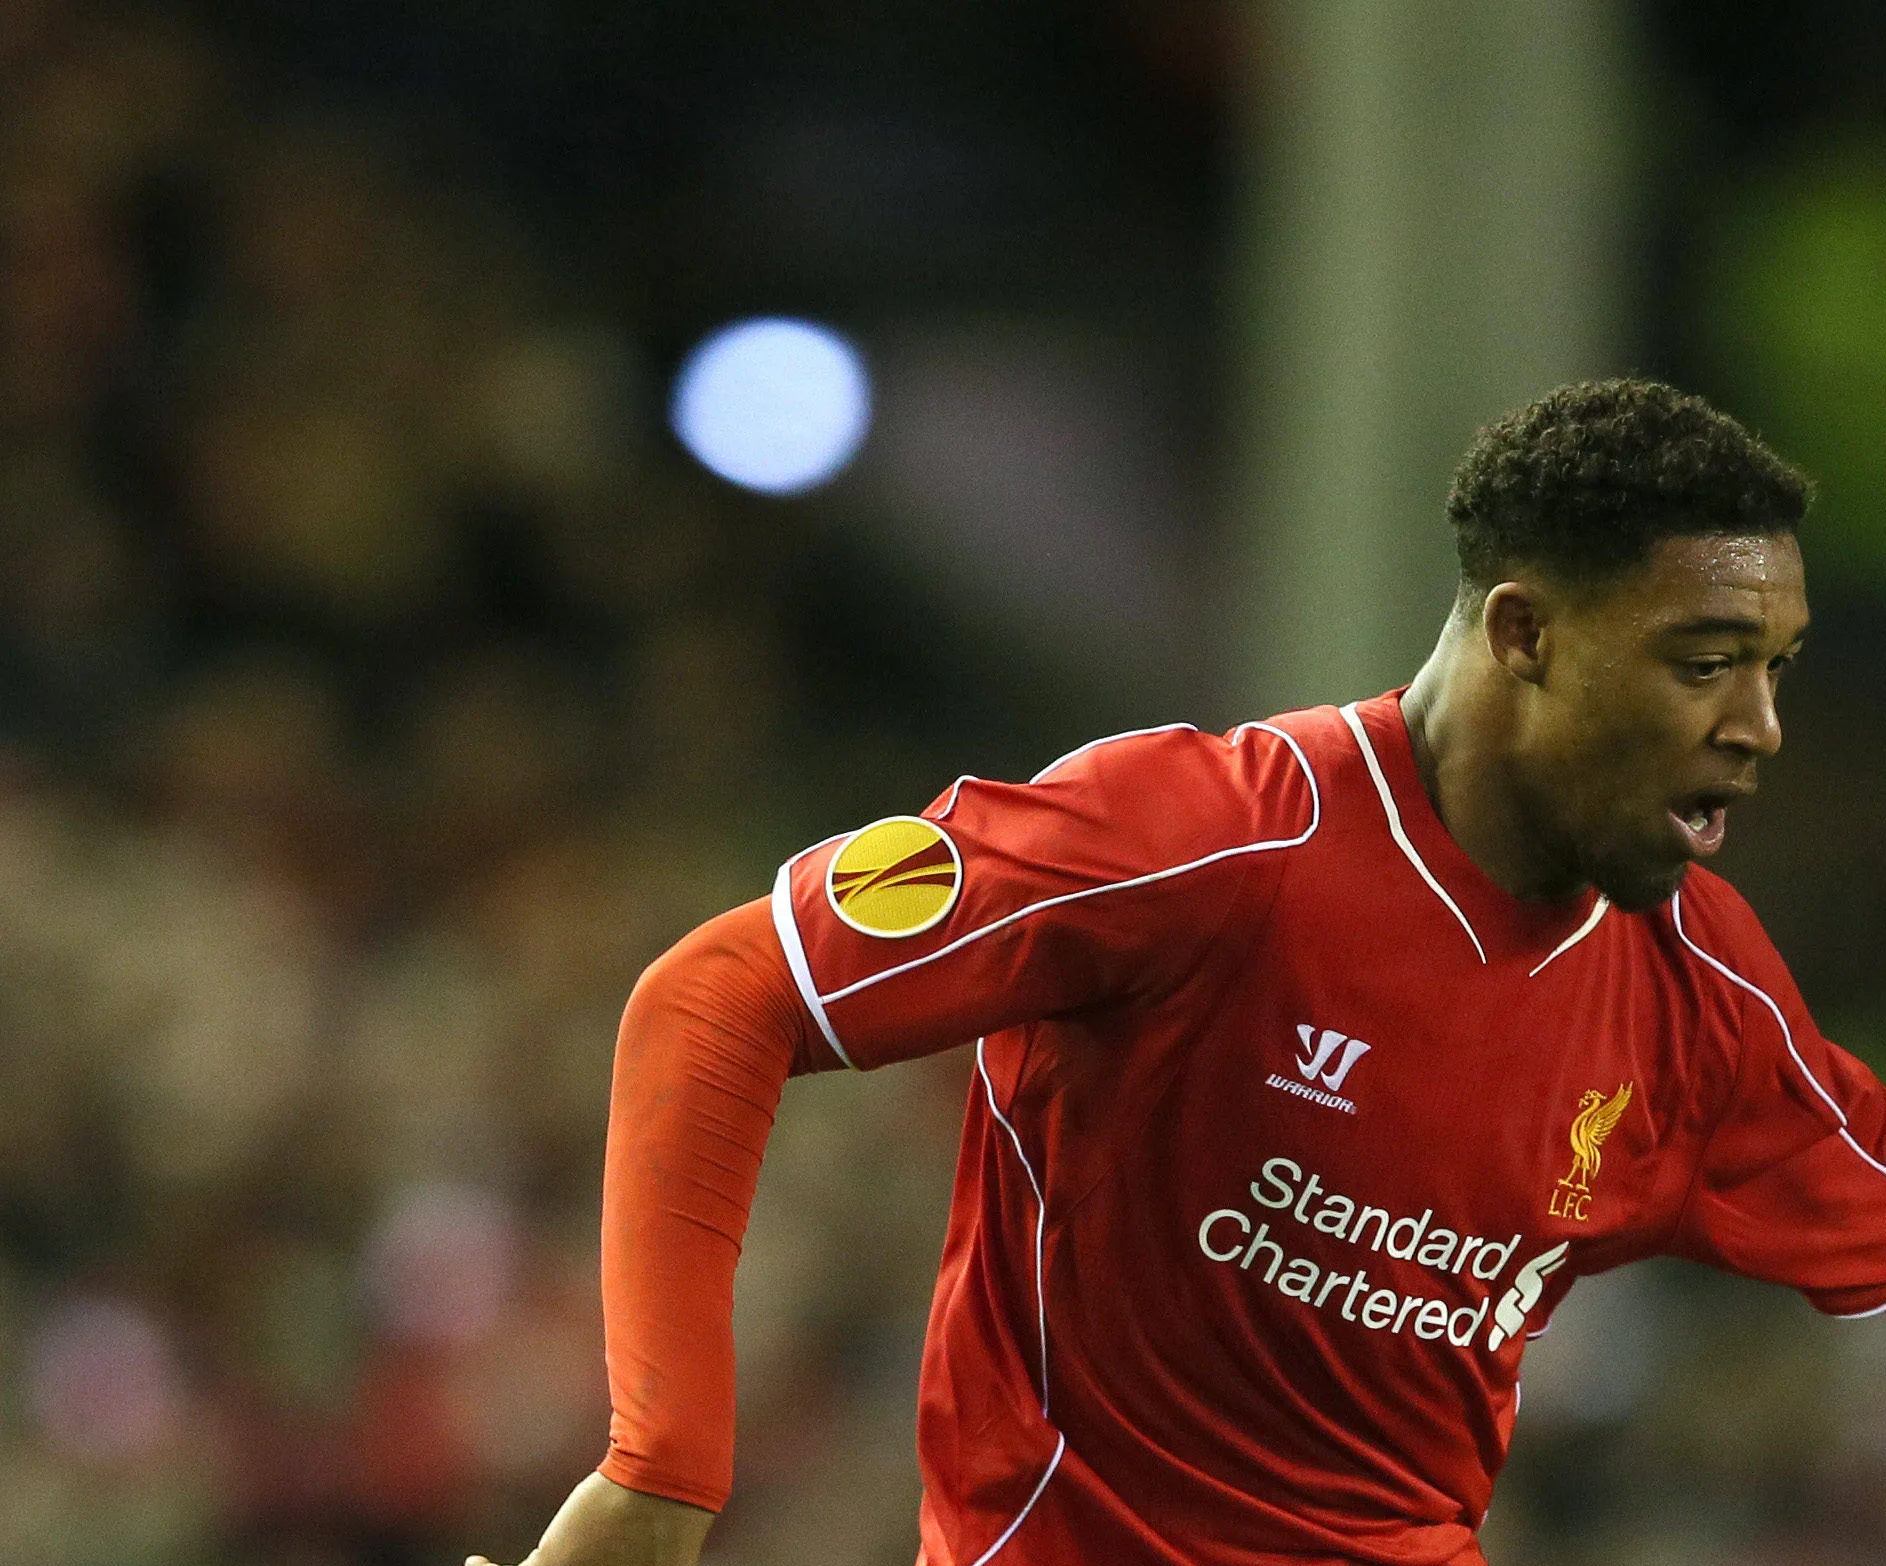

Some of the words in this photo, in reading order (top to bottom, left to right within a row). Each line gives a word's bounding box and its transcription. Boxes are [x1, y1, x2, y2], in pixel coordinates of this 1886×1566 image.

[1265, 1074, 1353, 1113] WARRIOR
[1199, 1209, 1489, 1348] Chartered
[1250, 1157, 1521, 1281] Standard
